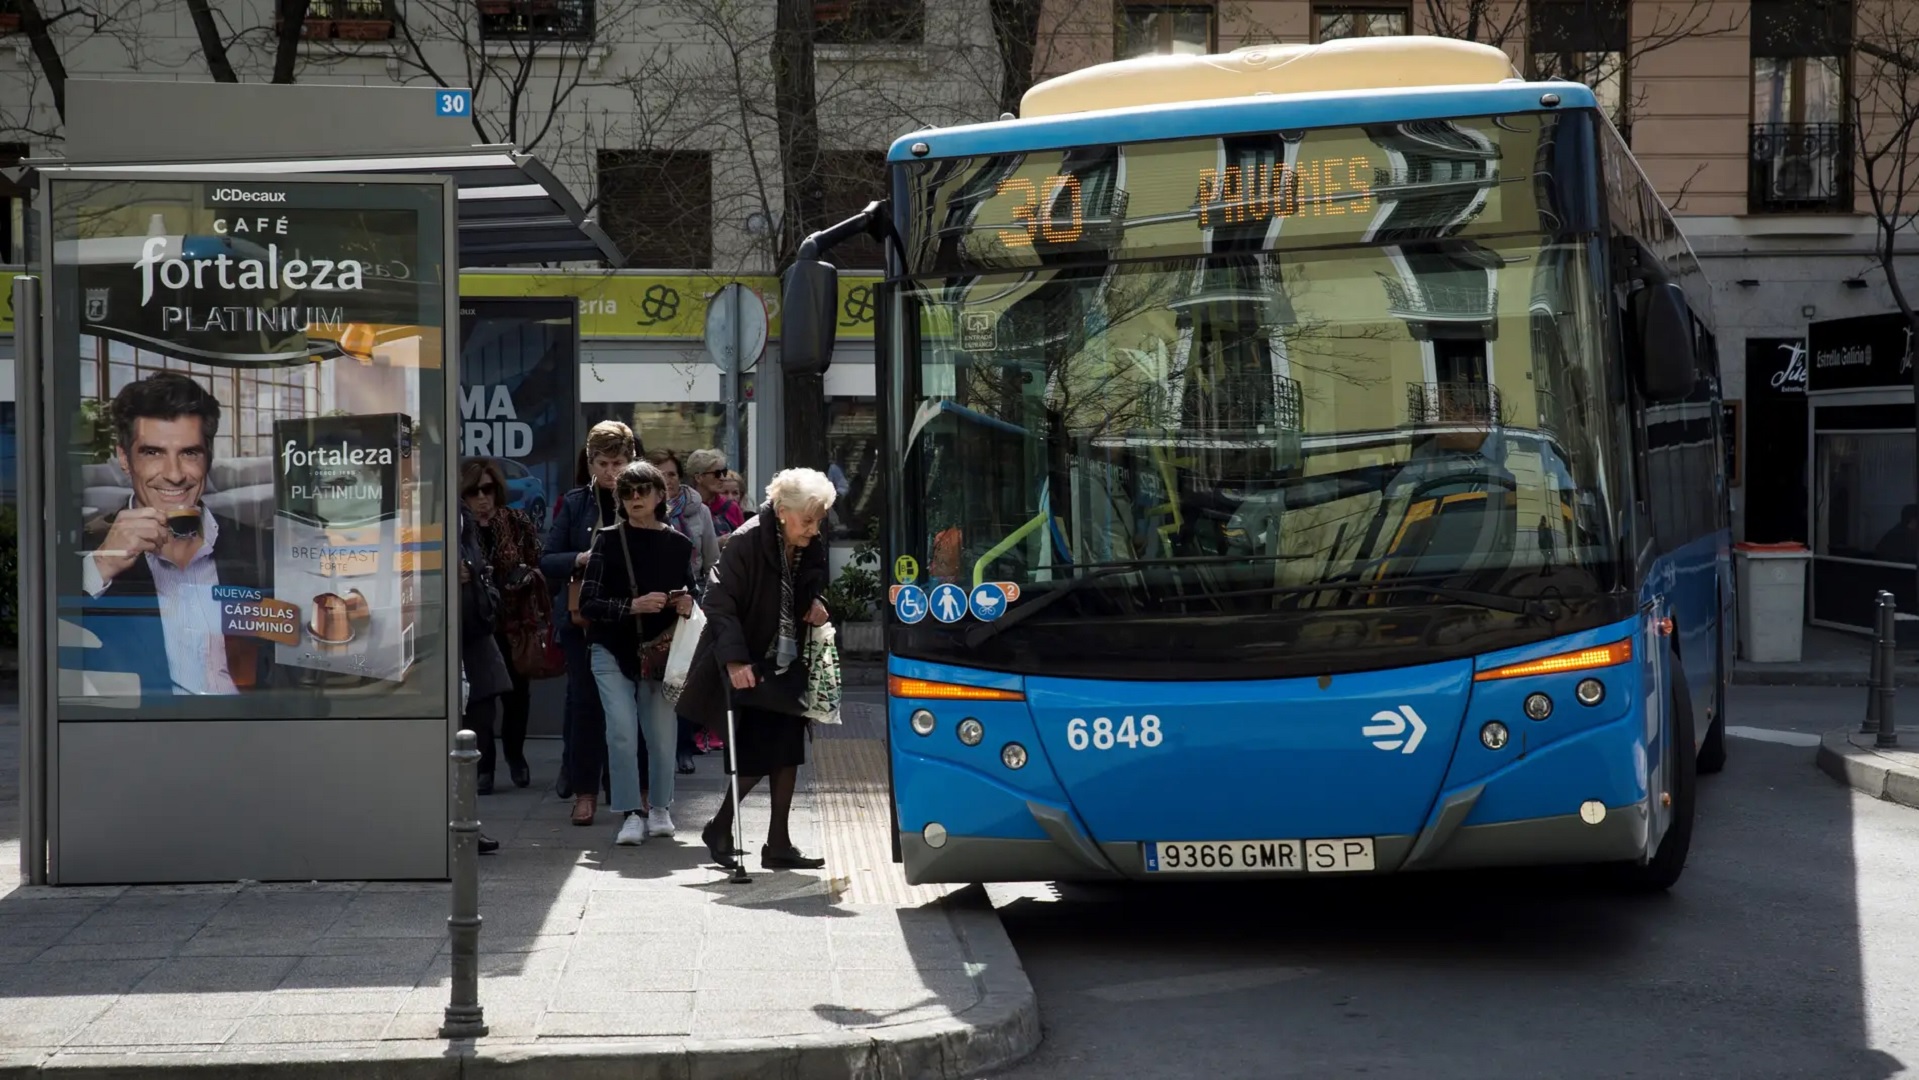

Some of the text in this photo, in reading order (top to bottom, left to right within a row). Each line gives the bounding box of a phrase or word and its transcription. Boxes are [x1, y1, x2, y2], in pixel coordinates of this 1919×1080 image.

[441, 94, 465, 113] 30
[211, 188, 286, 202] JCDecaux
[997, 156, 1371, 247] 30 PAVONES
[213, 216, 289, 235] CAFÉ
[133, 237, 363, 307] fortaleza
[162, 306, 343, 332] PLATINIUM
[1816, 349, 1841, 368] Estrella
[459, 422, 533, 457] RID
[281, 440, 392, 475] fortaleza
[291, 485, 383, 500] PLATINIUM
[292, 546, 378, 563] BREAKFAST
[320, 562, 348, 572] FORTE
[214, 588, 262, 600] NUEVAS
[224, 603, 294, 619] CÁPSULAS
[228, 619, 294, 634] ALUMINIO
[1067, 714, 1163, 751] 6848
[1165, 843, 1294, 868] 9366 GMR
